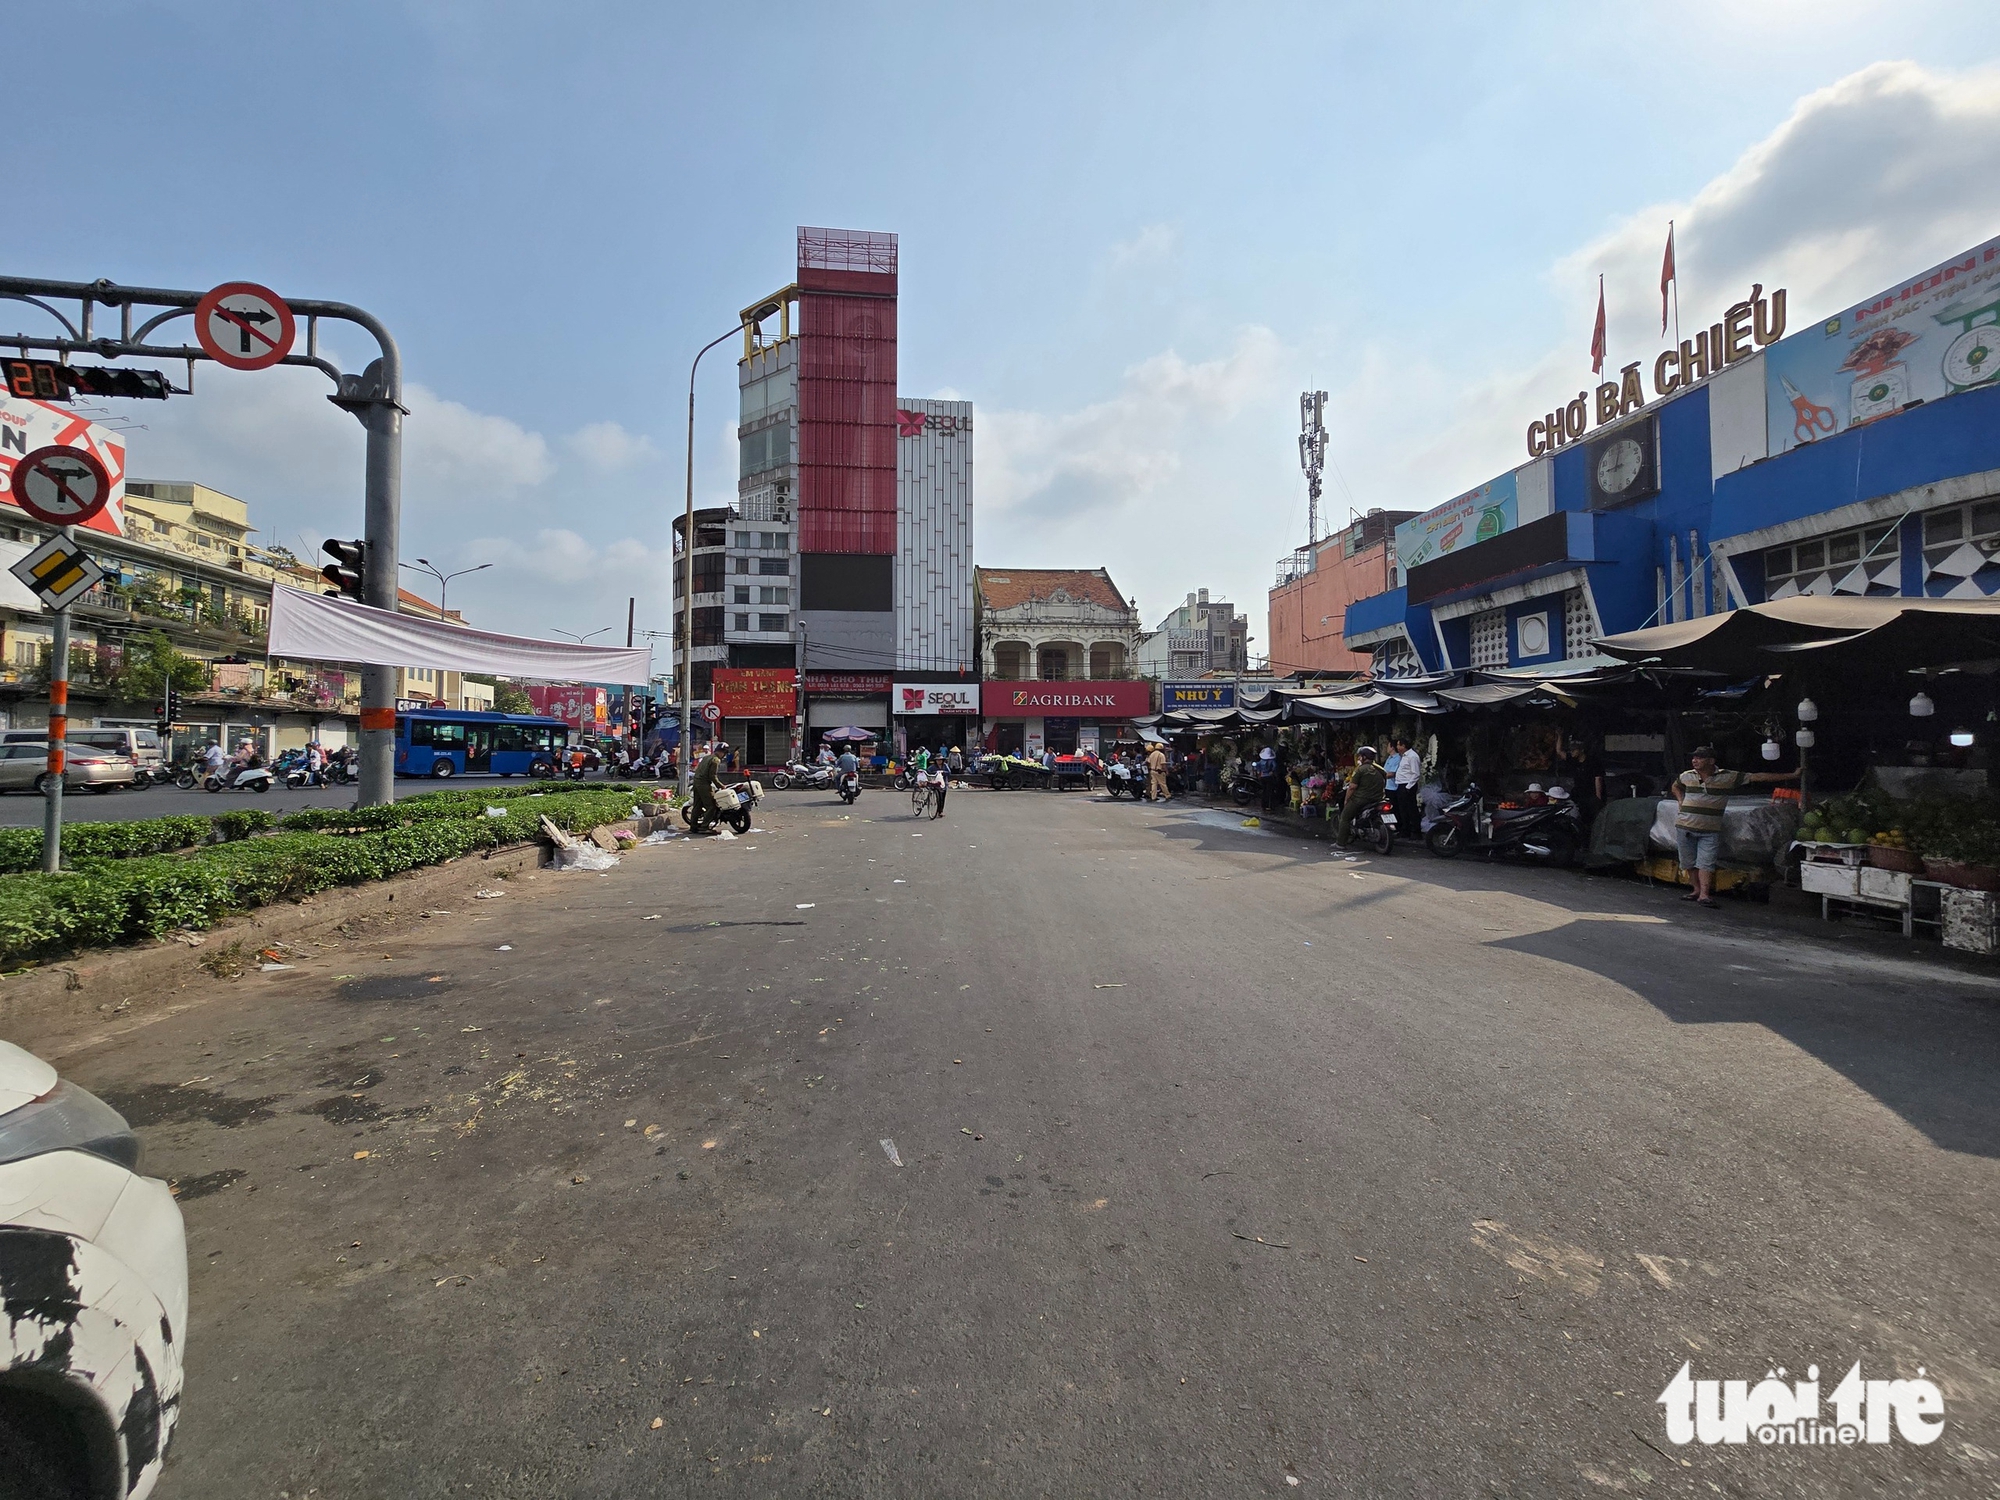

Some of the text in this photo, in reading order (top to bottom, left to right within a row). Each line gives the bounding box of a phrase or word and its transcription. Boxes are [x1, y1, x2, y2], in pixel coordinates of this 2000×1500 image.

[1855, 256, 1976, 322] NHƠN
[0, 410, 27, 427] OUP
[925, 414, 973, 431] SEOUL
[831, 675, 856, 684] CHO
[858, 675, 890, 684] THUÊ
[928, 692, 970, 704] SEOUL
[1029, 694, 1116, 706] AGRIBANK
[1175, 689, 1209, 701] NHƯ
